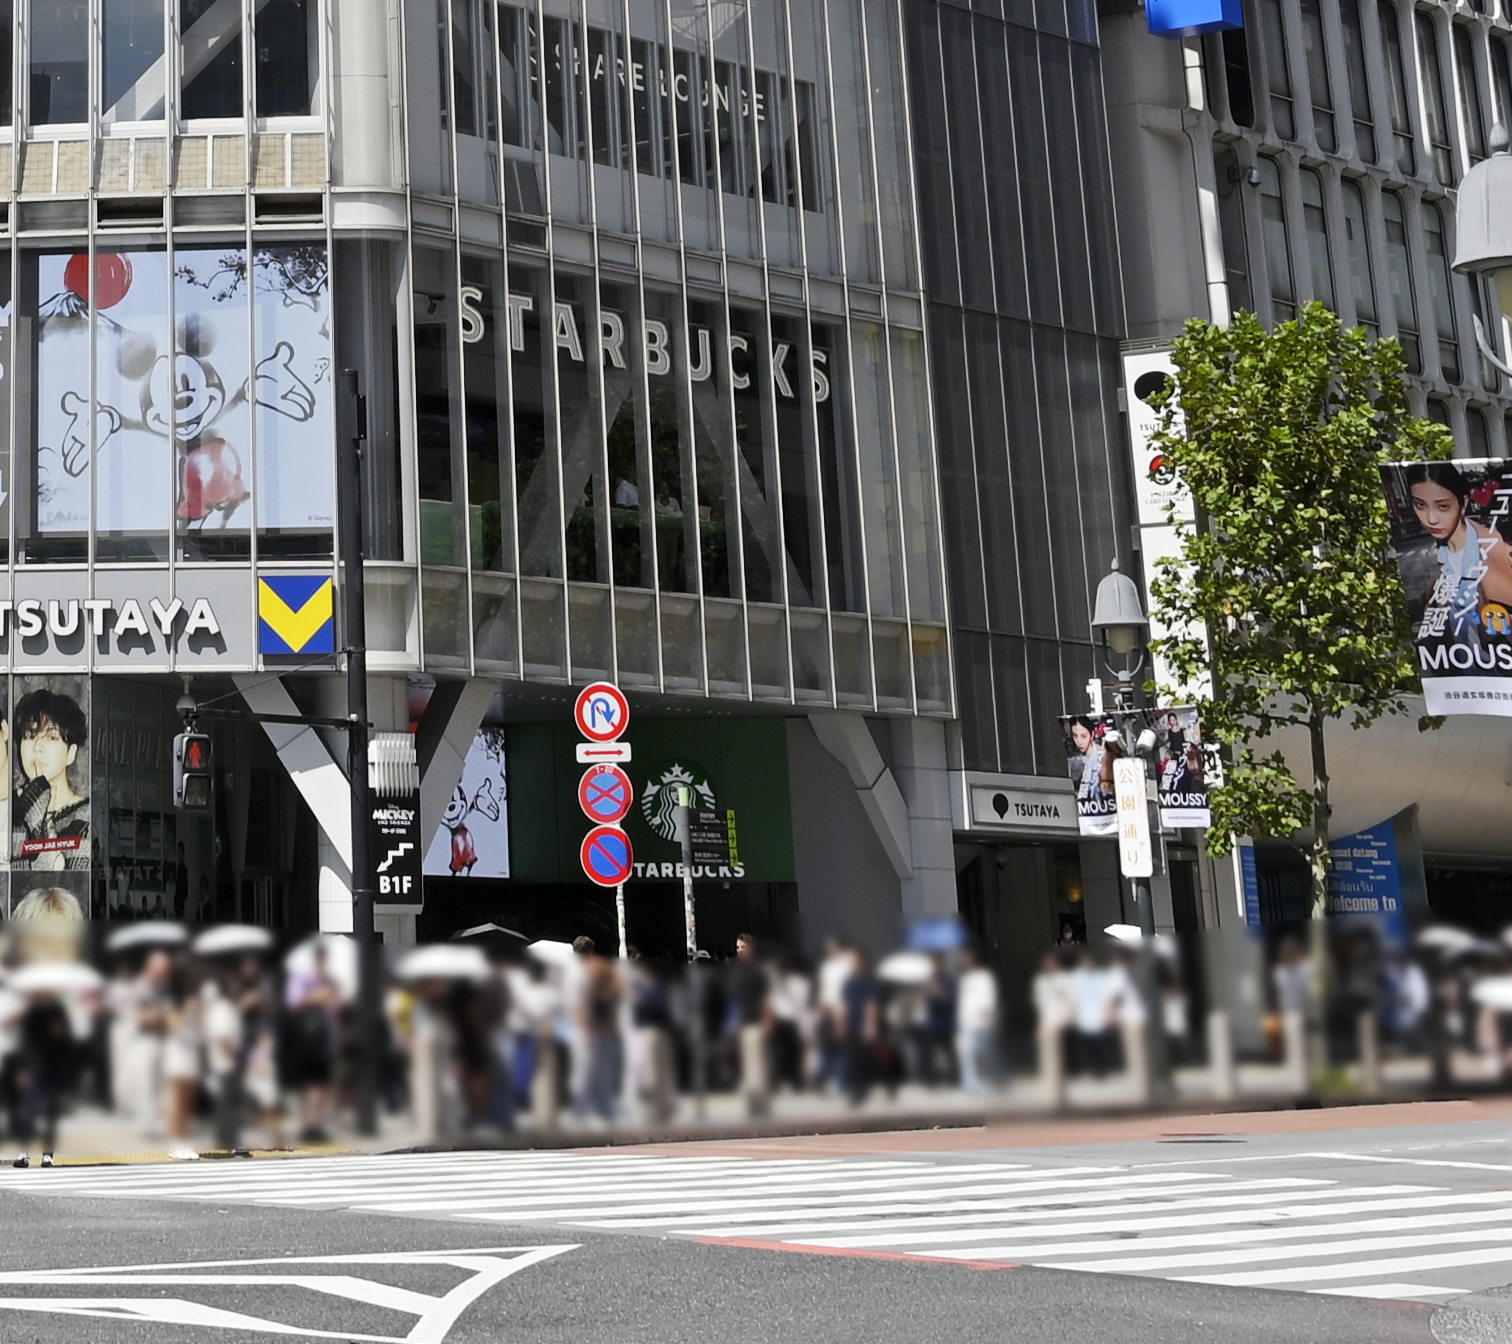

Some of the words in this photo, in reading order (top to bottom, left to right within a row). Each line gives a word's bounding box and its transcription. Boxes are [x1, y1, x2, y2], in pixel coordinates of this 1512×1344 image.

[460, 284, 832, 403] STARBUCKS
[1417, 572, 1460, 640] 爆誕
[1078, 799, 1117, 815] MOUS
[1159, 790, 1207, 807] MOUSSY
[1014, 801, 1061, 820] TSUTAYA
[1118, 766, 1139, 866] 公園通り
[631, 860, 746, 880] TARBUCKS
[379, 873, 413, 895] B1F
